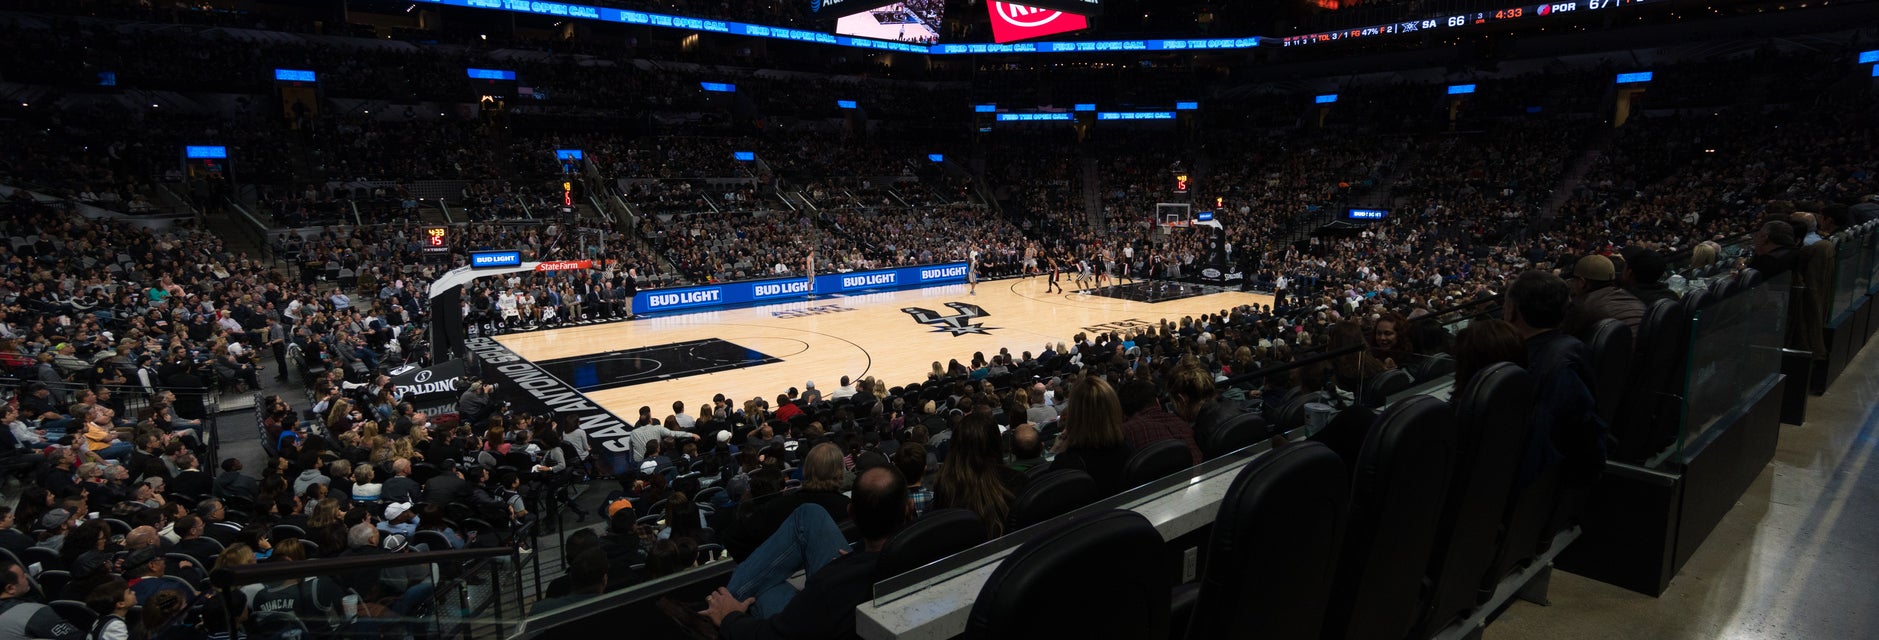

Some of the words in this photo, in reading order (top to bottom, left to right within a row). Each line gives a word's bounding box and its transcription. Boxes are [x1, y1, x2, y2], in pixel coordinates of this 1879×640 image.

[532, 2, 567, 15] OPEN
[568, 6, 599, 18] CAN.
[1495, 8, 1523, 19] 4:33
[1551, 2, 1577, 13] POR
[620, 11, 649, 23] FIND
[649, 15, 673, 26] THE
[673, 17, 703, 29] OPEN
[704, 21, 729, 32] CAN.
[1422, 20, 1437, 29] SA
[1448, 16, 1465, 27] 66
[746, 25, 770, 36] FIND
[771, 28, 790, 39] THE
[790, 31, 815, 42] OPEN
[816, 34, 837, 43] CAN.
[1318, 34, 1330, 42] TOL
[1351, 30, 1361, 38] FG
[1361, 28, 1379, 36] 47%
[1386, 26, 1393, 34] 2
[945, 45, 967, 53] FIND
[968, 45, 987, 53] THE
[987, 44, 1012, 52] OPEN
[1014, 43, 1036, 52] CAN.
[1053, 42, 1076, 51] FIND
[1076, 42, 1095, 51] THE
[1096, 42, 1121, 51] OPEN
[1122, 41, 1146, 50] CAN.
[1162, 40, 1186, 49] FIND
[1187, 40, 1207, 49] THE
[1208, 39, 1234, 48] OPEN
[1235, 38, 1257, 47] CAN.
[1178, 182, 1186, 190] 15
[431, 236, 442, 246] 15
[922, 269, 941, 279] BUD
[941, 266, 967, 277] LIGHT
[844, 277, 867, 288] BUD
[867, 273, 896, 285] LIGHT
[755, 284, 782, 296] BUD
[650, 295, 680, 307] BUD
[681, 290, 720, 304] LIGHT
[464, 336, 521, 364] SPURS
[497, 363, 599, 413] ANTONIO
[580, 413, 633, 452] SAN
[260, 598, 295, 612] DUNCAN
